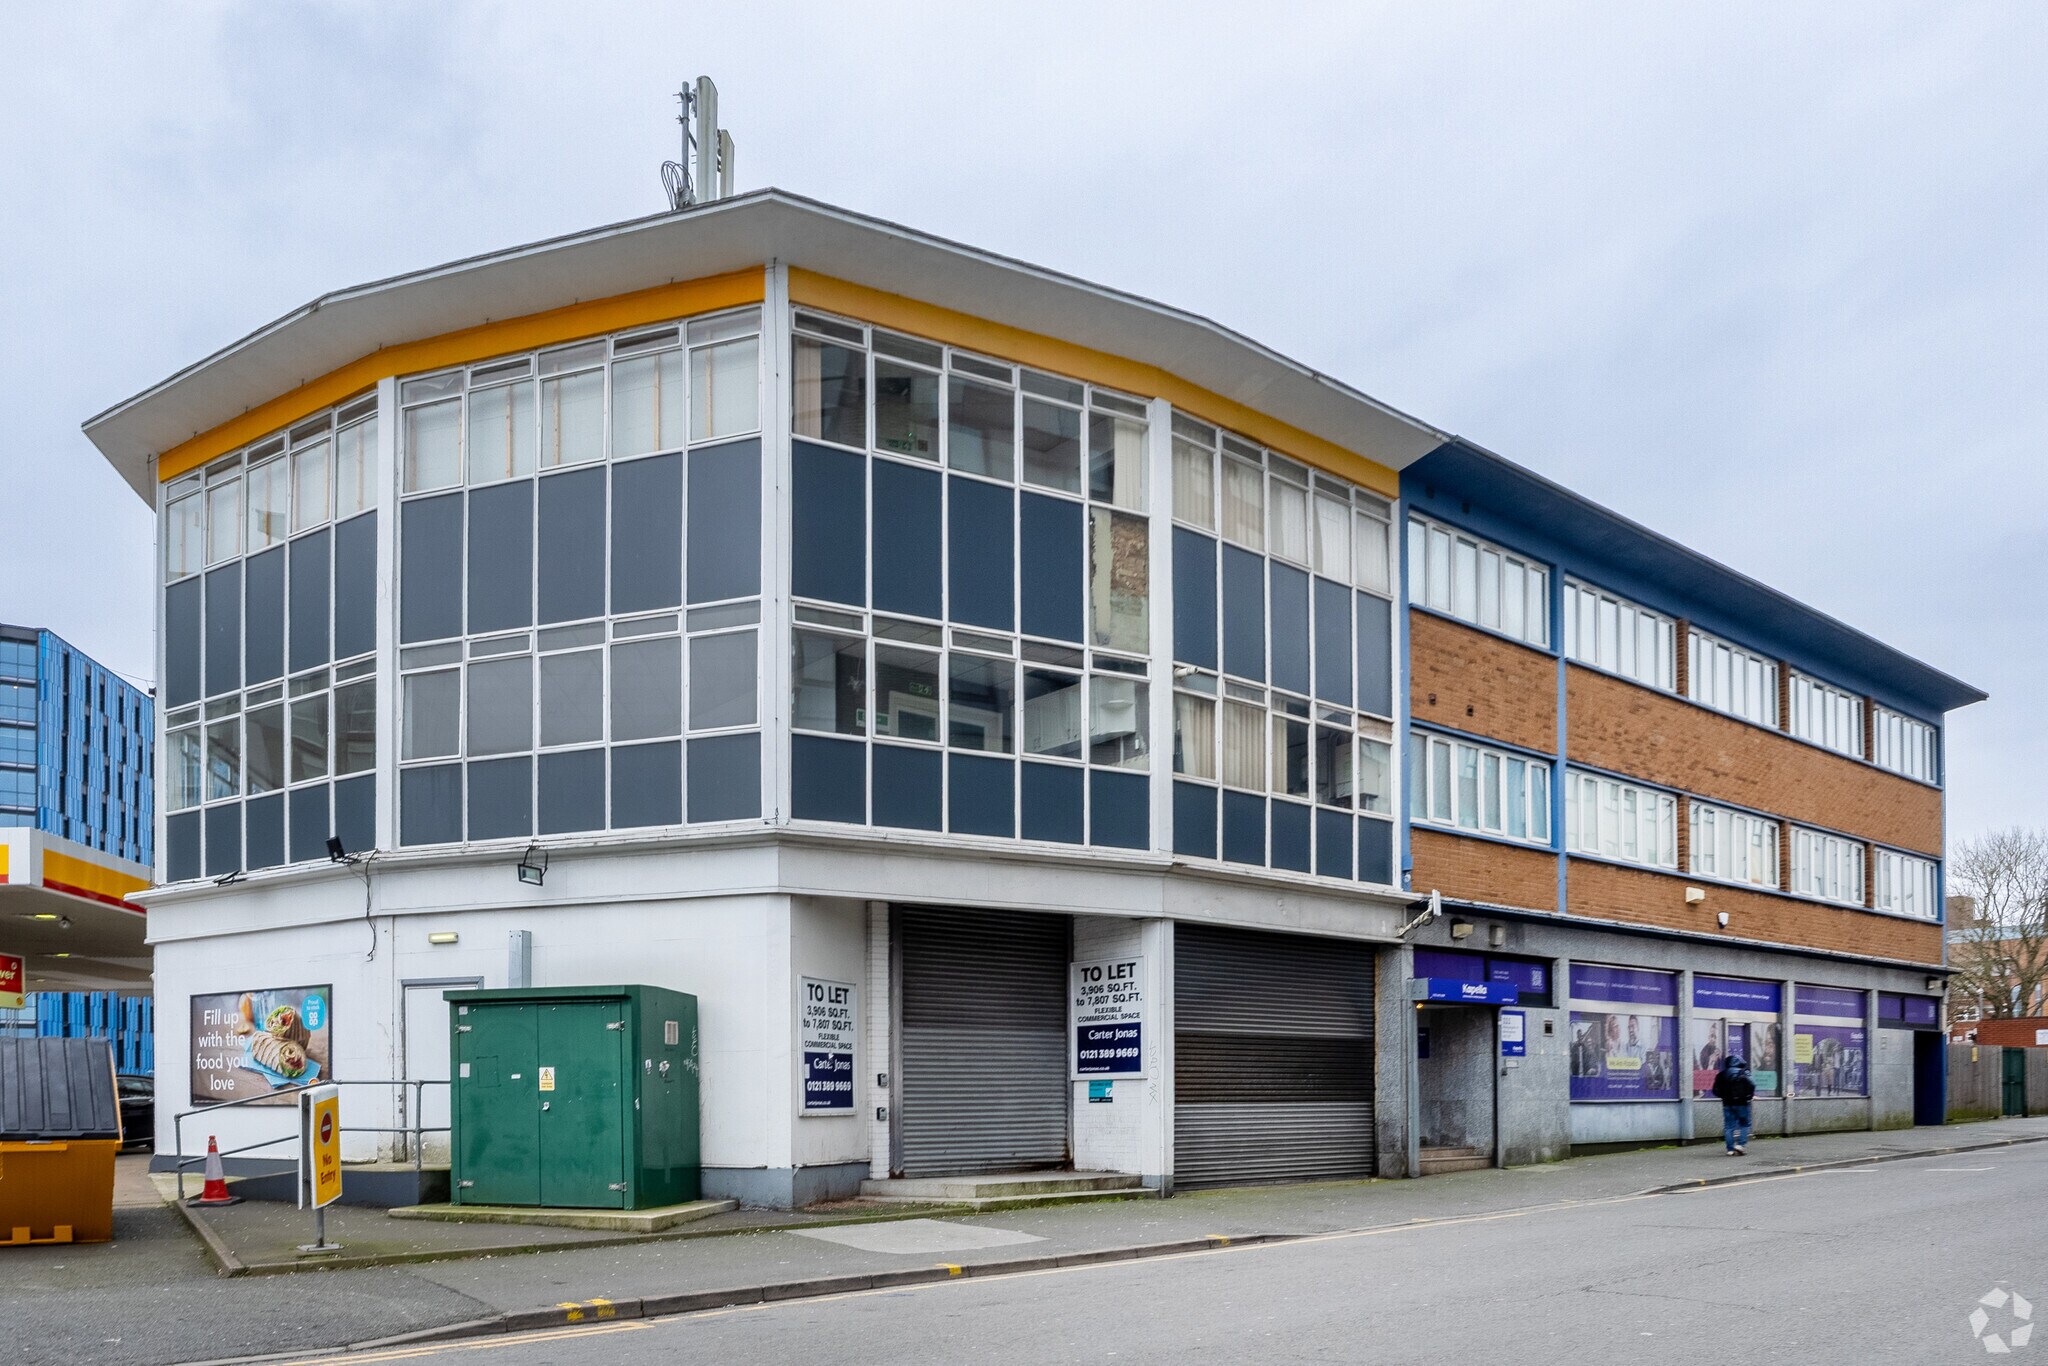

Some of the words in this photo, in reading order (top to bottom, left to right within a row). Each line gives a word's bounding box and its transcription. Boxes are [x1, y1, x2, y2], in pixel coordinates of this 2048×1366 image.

[1081, 966, 1102, 983] TO
[1108, 962, 1136, 980] LET
[807, 983, 824, 1002] TO
[828, 985, 849, 1005] LET
[1081, 985, 1104, 997] 3,906
[1107, 982, 1137, 993] SQ.FT.
[1076, 998, 1085, 1006] to
[1088, 995, 1109, 1007] 7,807
[1112, 992, 1142, 1003] SQ.FT.
[807, 1005, 826, 1018] 3,906
[828, 1007, 850, 1019] SQ.FT.
[1094, 1006, 1122, 1014] FLEXIBLE
[203, 1009, 221, 1026] Fill
[223, 1012, 239, 1028] up
[1077, 1014, 1118, 1023] COMMERCIAL
[1120, 1012, 1141, 1020] SPACE
[803, 1018, 810, 1028] to
[813, 1018, 830, 1031] 7,807
[832, 1020, 854, 1032] SQ.FT.
[198, 1031, 222, 1047] with
[225, 1030, 246, 1047] the
[818, 1032, 840, 1041] FLEXIBLE
[1088, 1029, 1113, 1040] Carter
[1114, 1028, 1138, 1041] Jonas
[804, 1040, 837, 1049] COMMERCIAL
[838, 1042, 853, 1050] SPACE
[1080, 1049, 1098, 1059] 0121
[1099, 1048, 1115, 1059] 389
[1116, 1047, 1139, 1058] 9669
[196, 1053, 223, 1070] food
[226, 1056, 249, 1072] you
[833, 1058, 851, 1072] Jonas
[210, 1074, 235, 1091] love
[806, 1080, 822, 1092] 0121
[822, 1080, 834, 1092] 389
[835, 1080, 852, 1092] 9669
[323, 1153, 332, 1167] No
[320, 1169, 337, 1185] Entry
